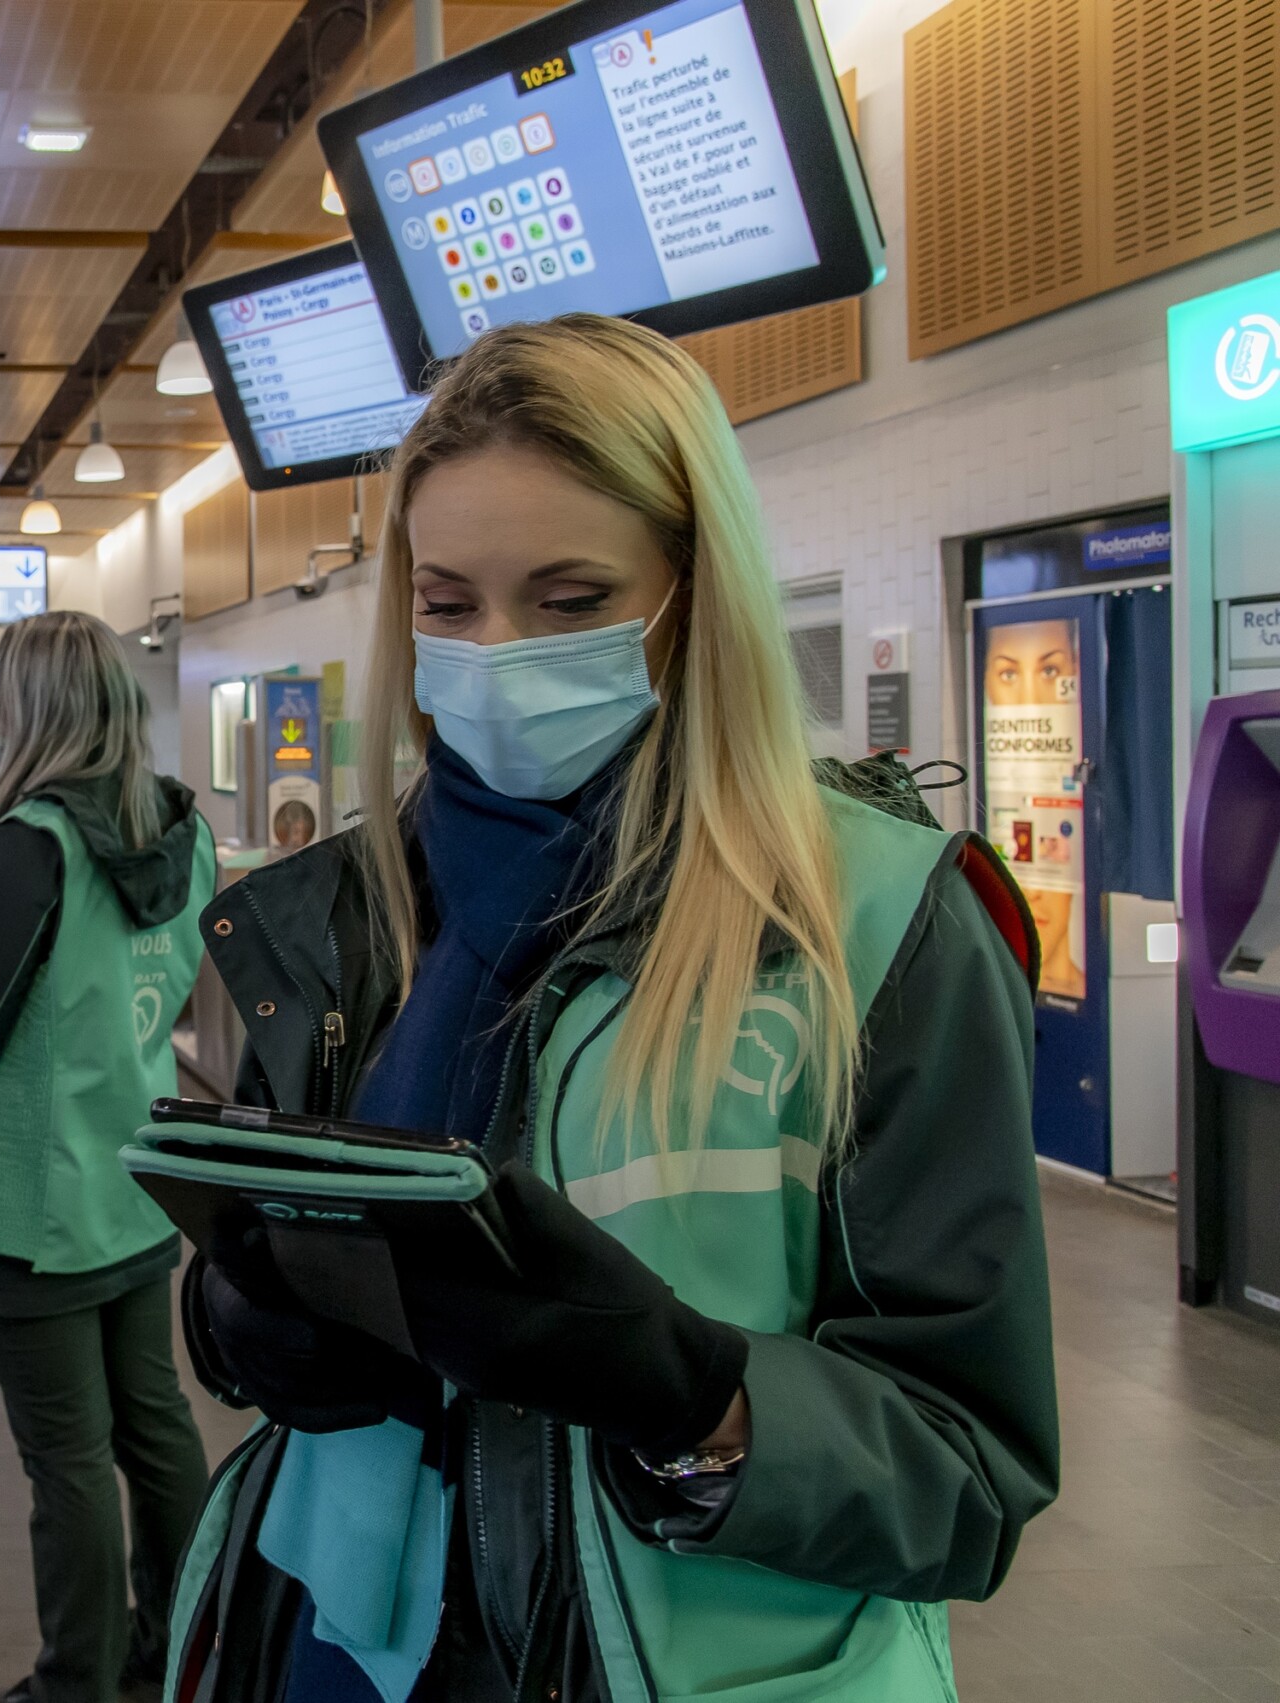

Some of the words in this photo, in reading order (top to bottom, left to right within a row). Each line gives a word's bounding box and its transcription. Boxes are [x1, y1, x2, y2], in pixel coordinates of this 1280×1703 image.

[521, 57, 567, 90] 10:32
[611, 79, 649, 99] Trafic
[652, 54, 710, 87] perturbé
[618, 102, 636, 117] sur
[639, 75, 710, 108] l'ensemble
[712, 67, 731, 83] de
[372, 120, 448, 159] Information
[446, 101, 489, 128] Trafic
[622, 120, 635, 133] la
[637, 109, 668, 128] ligne
[671, 95, 705, 116] suite
[707, 91, 717, 104] à
[628, 133, 651, 149] une
[654, 116, 702, 140] mesure
[704, 109, 722, 124] de
[633, 139, 683, 165] sécurité
[687, 119, 748, 147] survenue
[648, 161, 670, 178] Val
[673, 156, 690, 171] de
[739, 135, 758, 150] un
[643, 176, 688, 199] bagage
[691, 160, 733, 182] oublié
[736, 155, 751, 170] et
[649, 197, 677, 215] d'un
[679, 182, 723, 205] défaut
[654, 192, 749, 231] d'alimentation
[752, 184, 777, 202] aux
[660, 225, 702, 247] abords
[704, 219, 721, 234] de
[664, 223, 775, 262] Maisons-Laffitte.
[988, 718, 1052, 734] IDENTITES
[988, 738, 1073, 753] CONFORMES
[131, 932, 173, 958] VOUS
[134, 971, 168, 985] RATP
